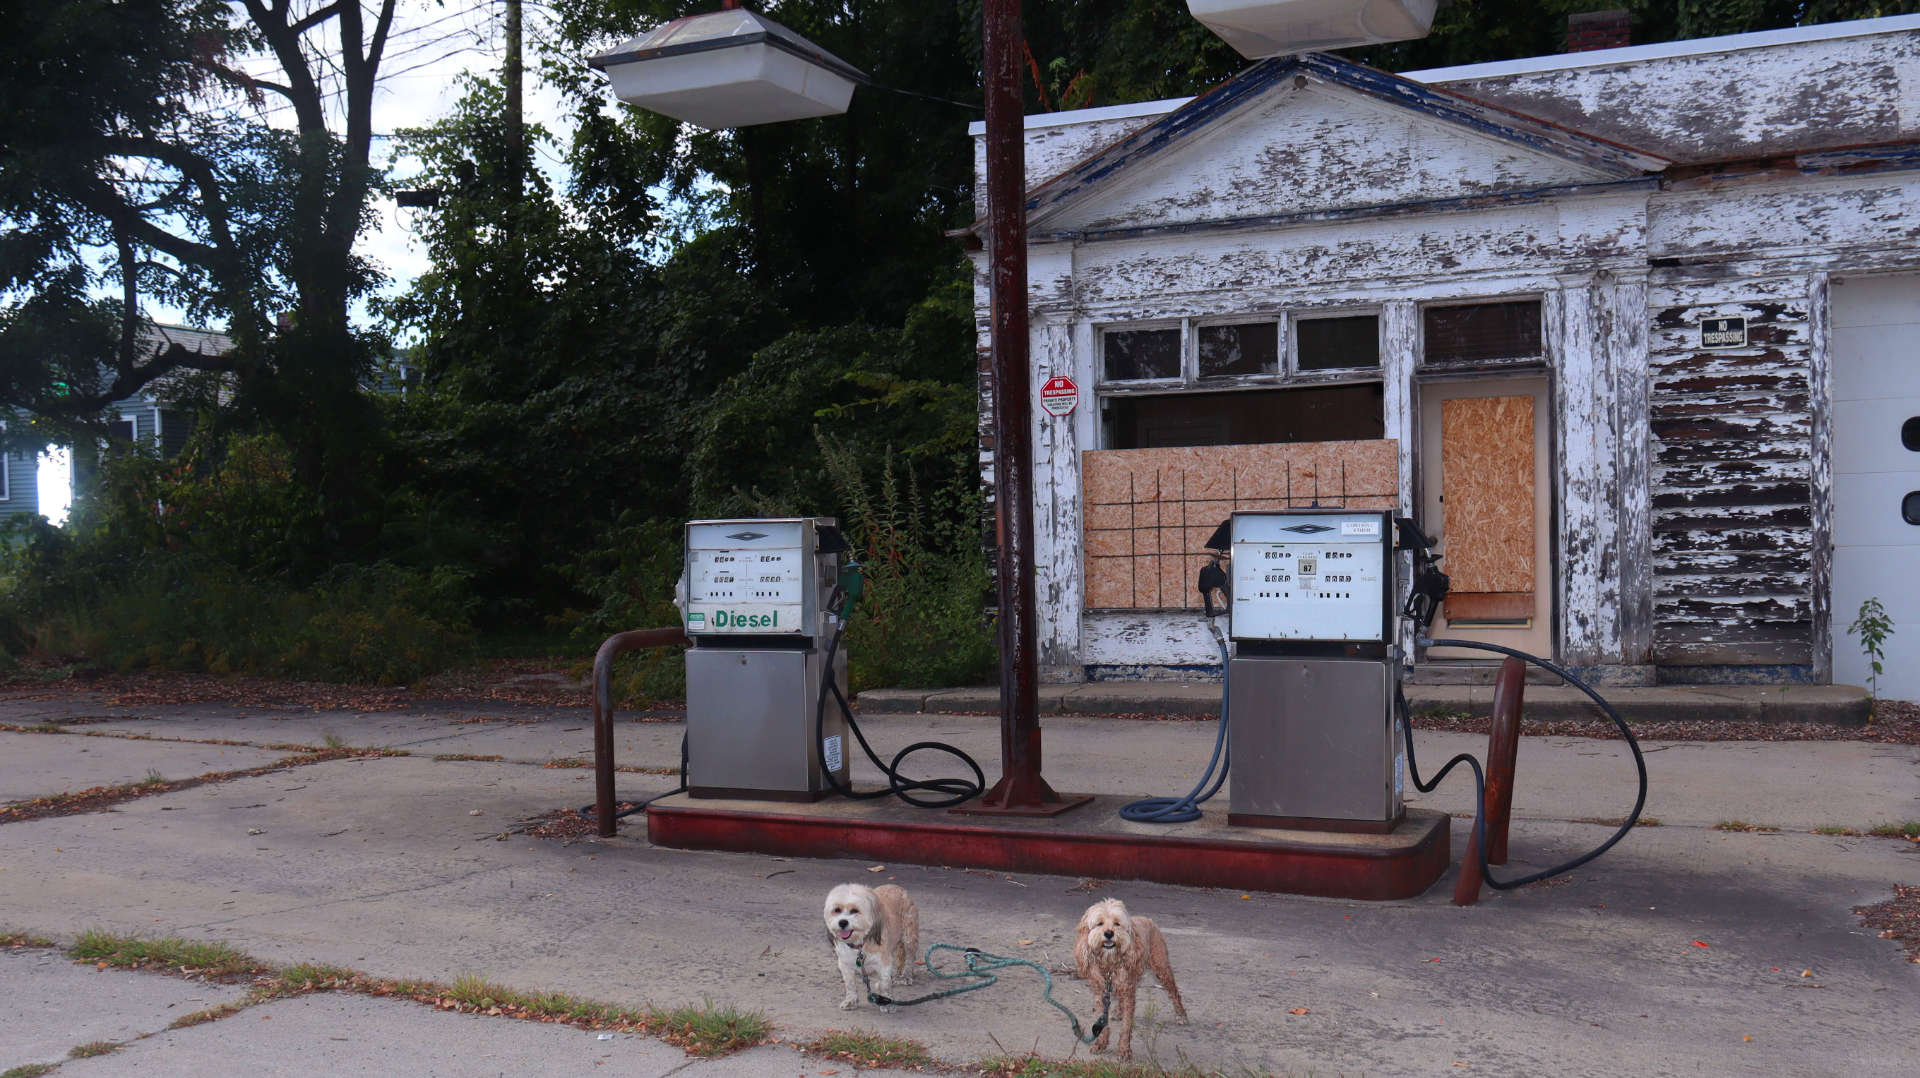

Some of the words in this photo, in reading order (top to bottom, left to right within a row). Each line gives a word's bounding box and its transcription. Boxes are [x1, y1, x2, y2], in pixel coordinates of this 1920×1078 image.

[1718, 320, 1728, 331] NO
[1703, 330, 1743, 344] TRESPASSING
[1303, 564, 1313, 572] 87
[715, 610, 778, 628] Diesel
